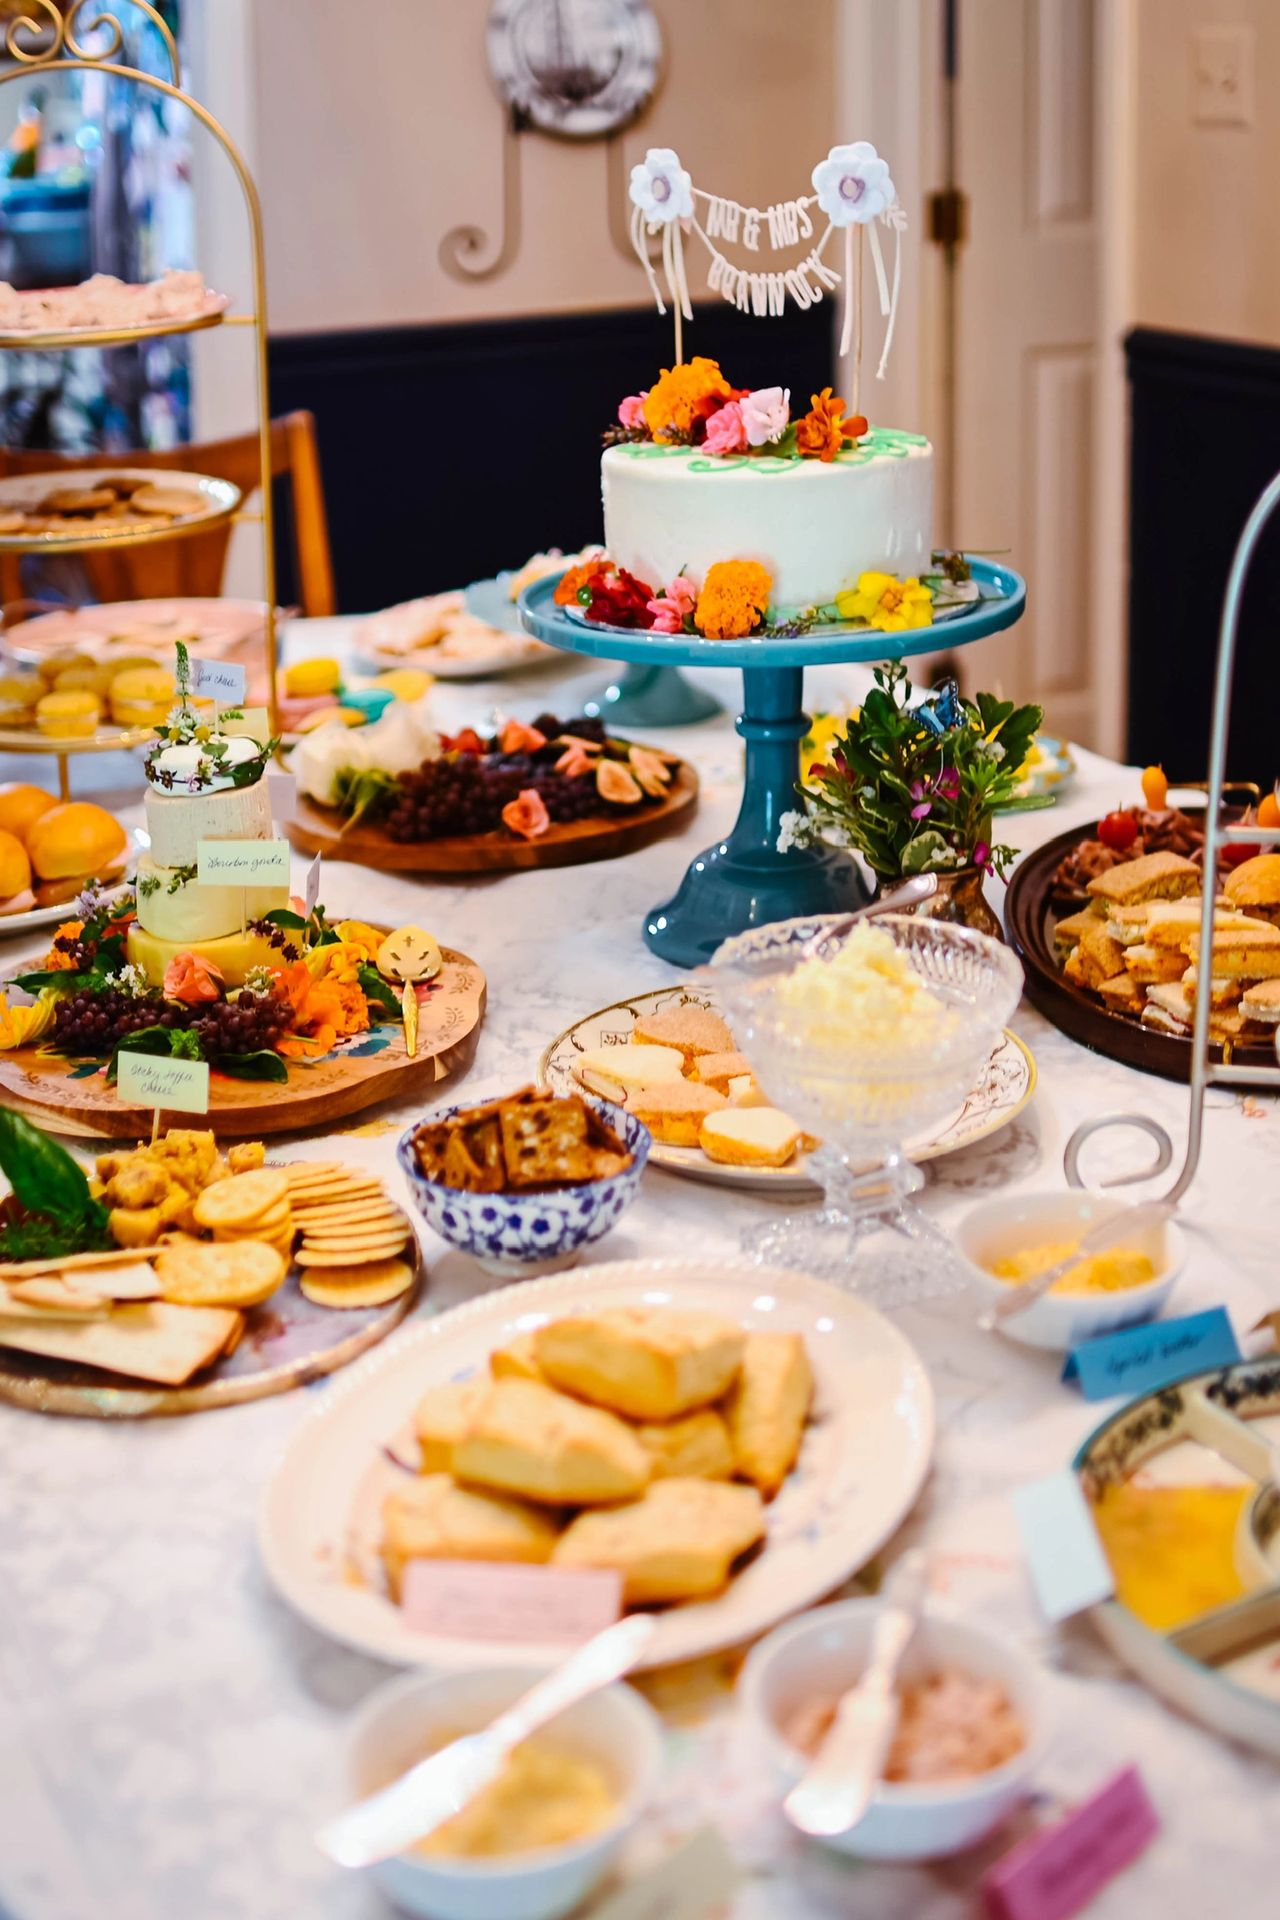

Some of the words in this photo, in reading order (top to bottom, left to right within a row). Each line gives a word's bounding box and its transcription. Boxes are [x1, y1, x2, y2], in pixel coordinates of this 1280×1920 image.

[706, 195, 740, 243] MR
[742, 207, 761, 251] &
[767, 196, 813, 250] MRS
[706, 248, 841, 317] BRANNOCK
